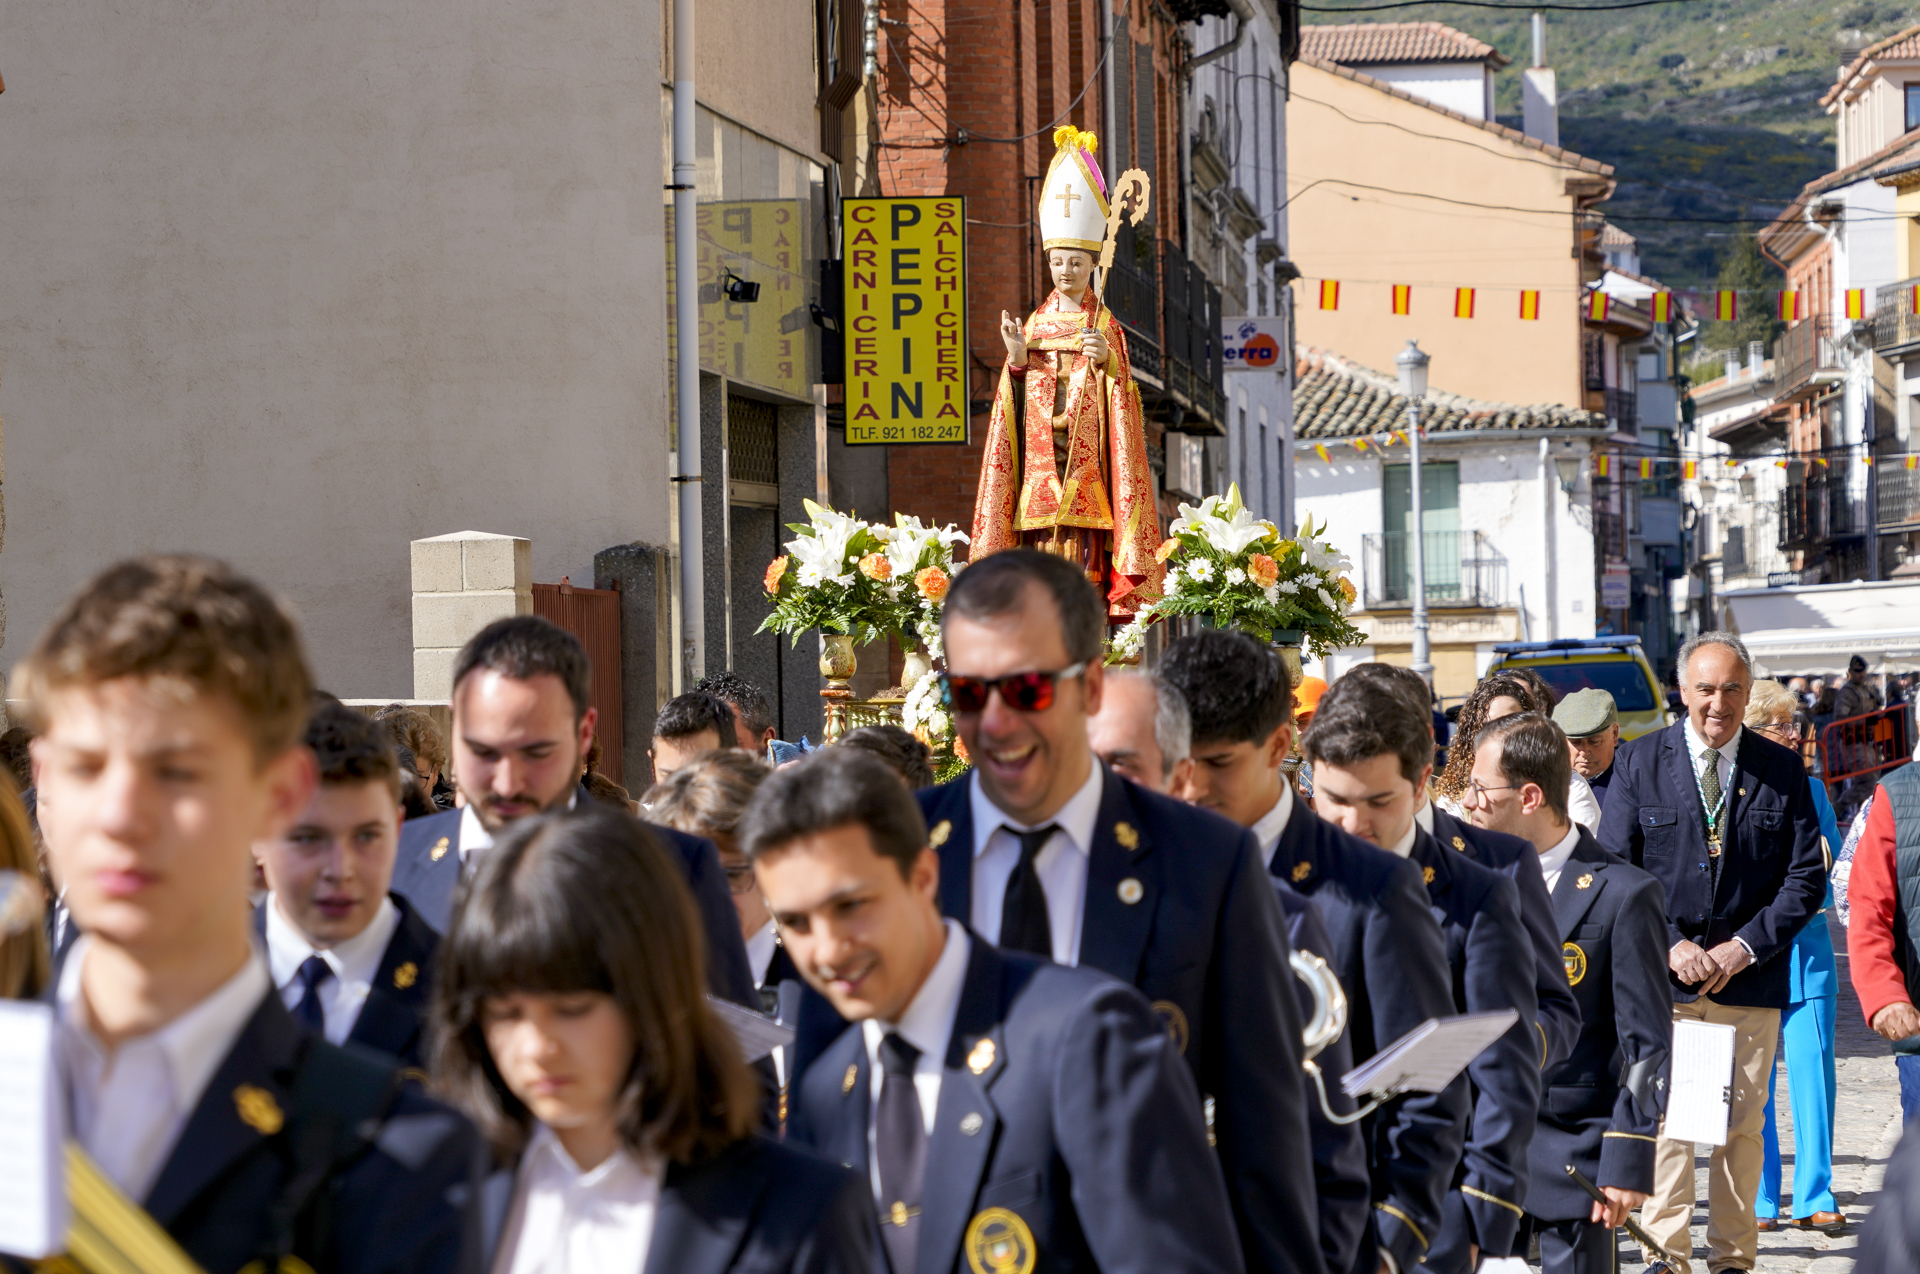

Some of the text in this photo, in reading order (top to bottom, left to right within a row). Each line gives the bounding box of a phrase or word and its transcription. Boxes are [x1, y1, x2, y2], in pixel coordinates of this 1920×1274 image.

[851, 206, 881, 421] CARNICERIA
[890, 203, 923, 419] PEPIN
[933, 202, 961, 419] SALCHICHERIA
[1224, 347, 1272, 360] erra
[851, 425, 961, 440] TLF. 921 182 247
